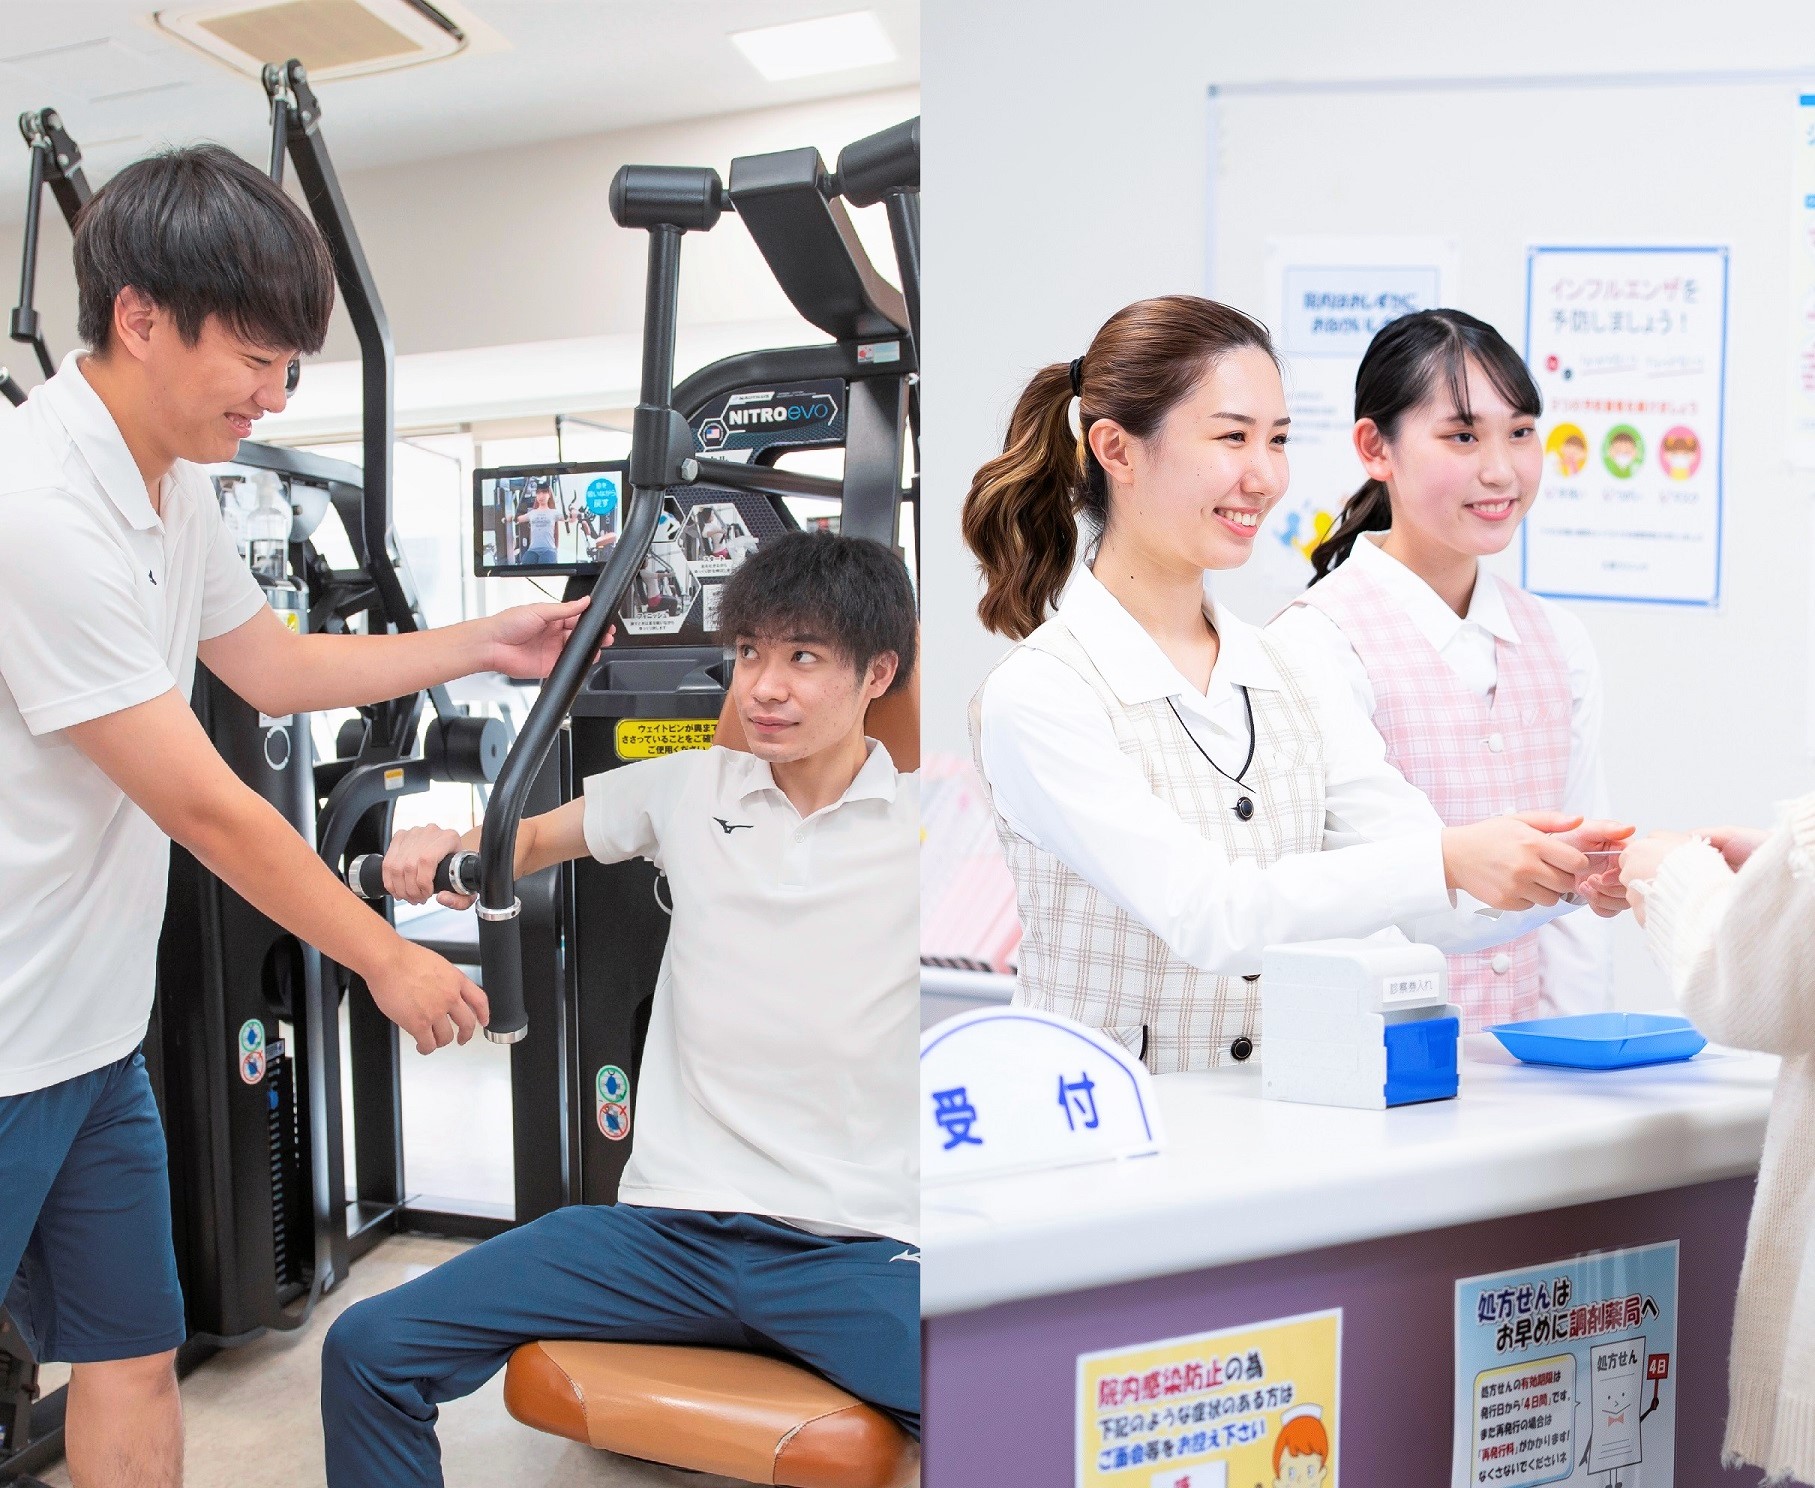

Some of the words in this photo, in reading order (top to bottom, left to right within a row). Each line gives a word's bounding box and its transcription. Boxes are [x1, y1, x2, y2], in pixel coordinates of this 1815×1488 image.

[1552, 279, 1697, 303] インフルエンザを
[729, 403, 828, 425] NITROevo
[622, 734, 714, 744] ささっていることをご確
[932, 1071, 1099, 1150] 受付
[1478, 1280, 1570, 1322] 処方せんは
[1496, 1296, 1658, 1351] お早めに調剤薬局へ
[1597, 1349, 1638, 1371] 処方せん
[1649, 1359, 1667, 1373] 4日
[1098, 1351, 1263, 1407] 院内感染防止の為
[1481, 1370, 1561, 1398] 処方せんの有効期限は
[1100, 1383, 1293, 1440] 下記のような症状のある方は
[1481, 1413, 1552, 1440] また再発行の場合は
[1100, 1418, 1266, 1470] ご面会等をお控え下さい
[1478, 1452, 1567, 1482] なくさないでくださいネ
